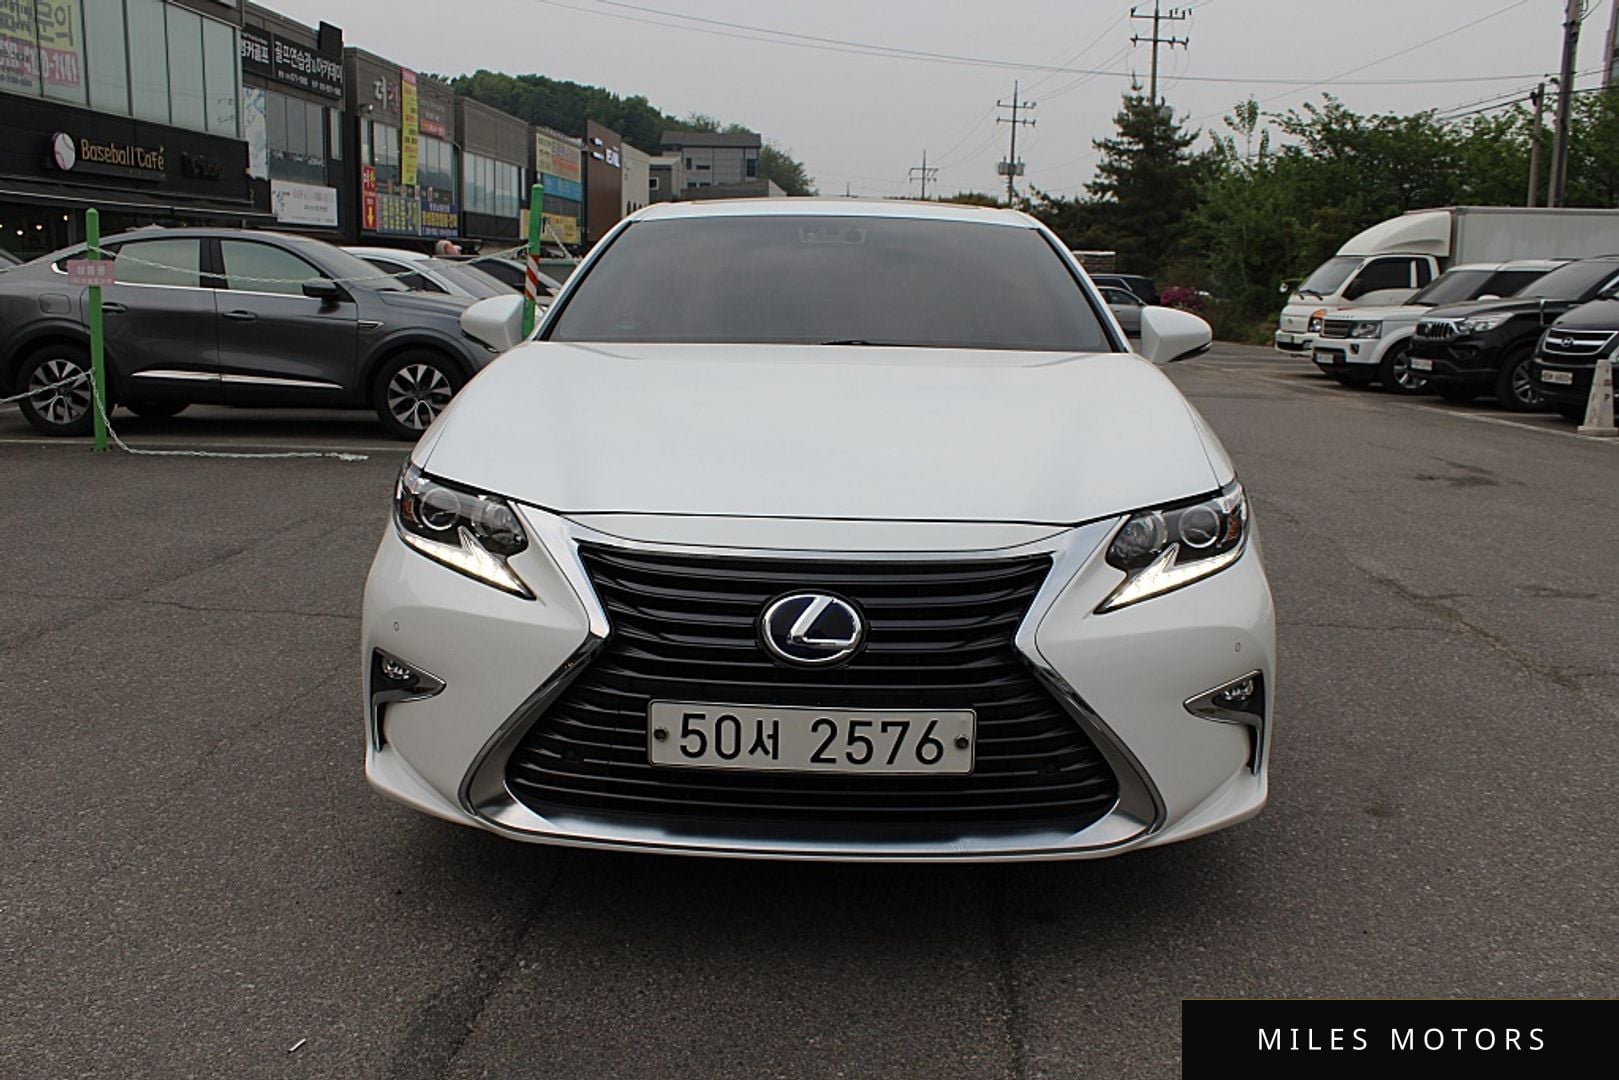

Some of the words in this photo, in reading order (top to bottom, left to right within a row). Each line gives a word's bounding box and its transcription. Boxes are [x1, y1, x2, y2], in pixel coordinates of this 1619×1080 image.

[81, 138, 134, 166] Baseball
[134, 145, 165, 171] Café
[679, 712, 780, 760] 50서
[809, 717, 945, 766] 2576
